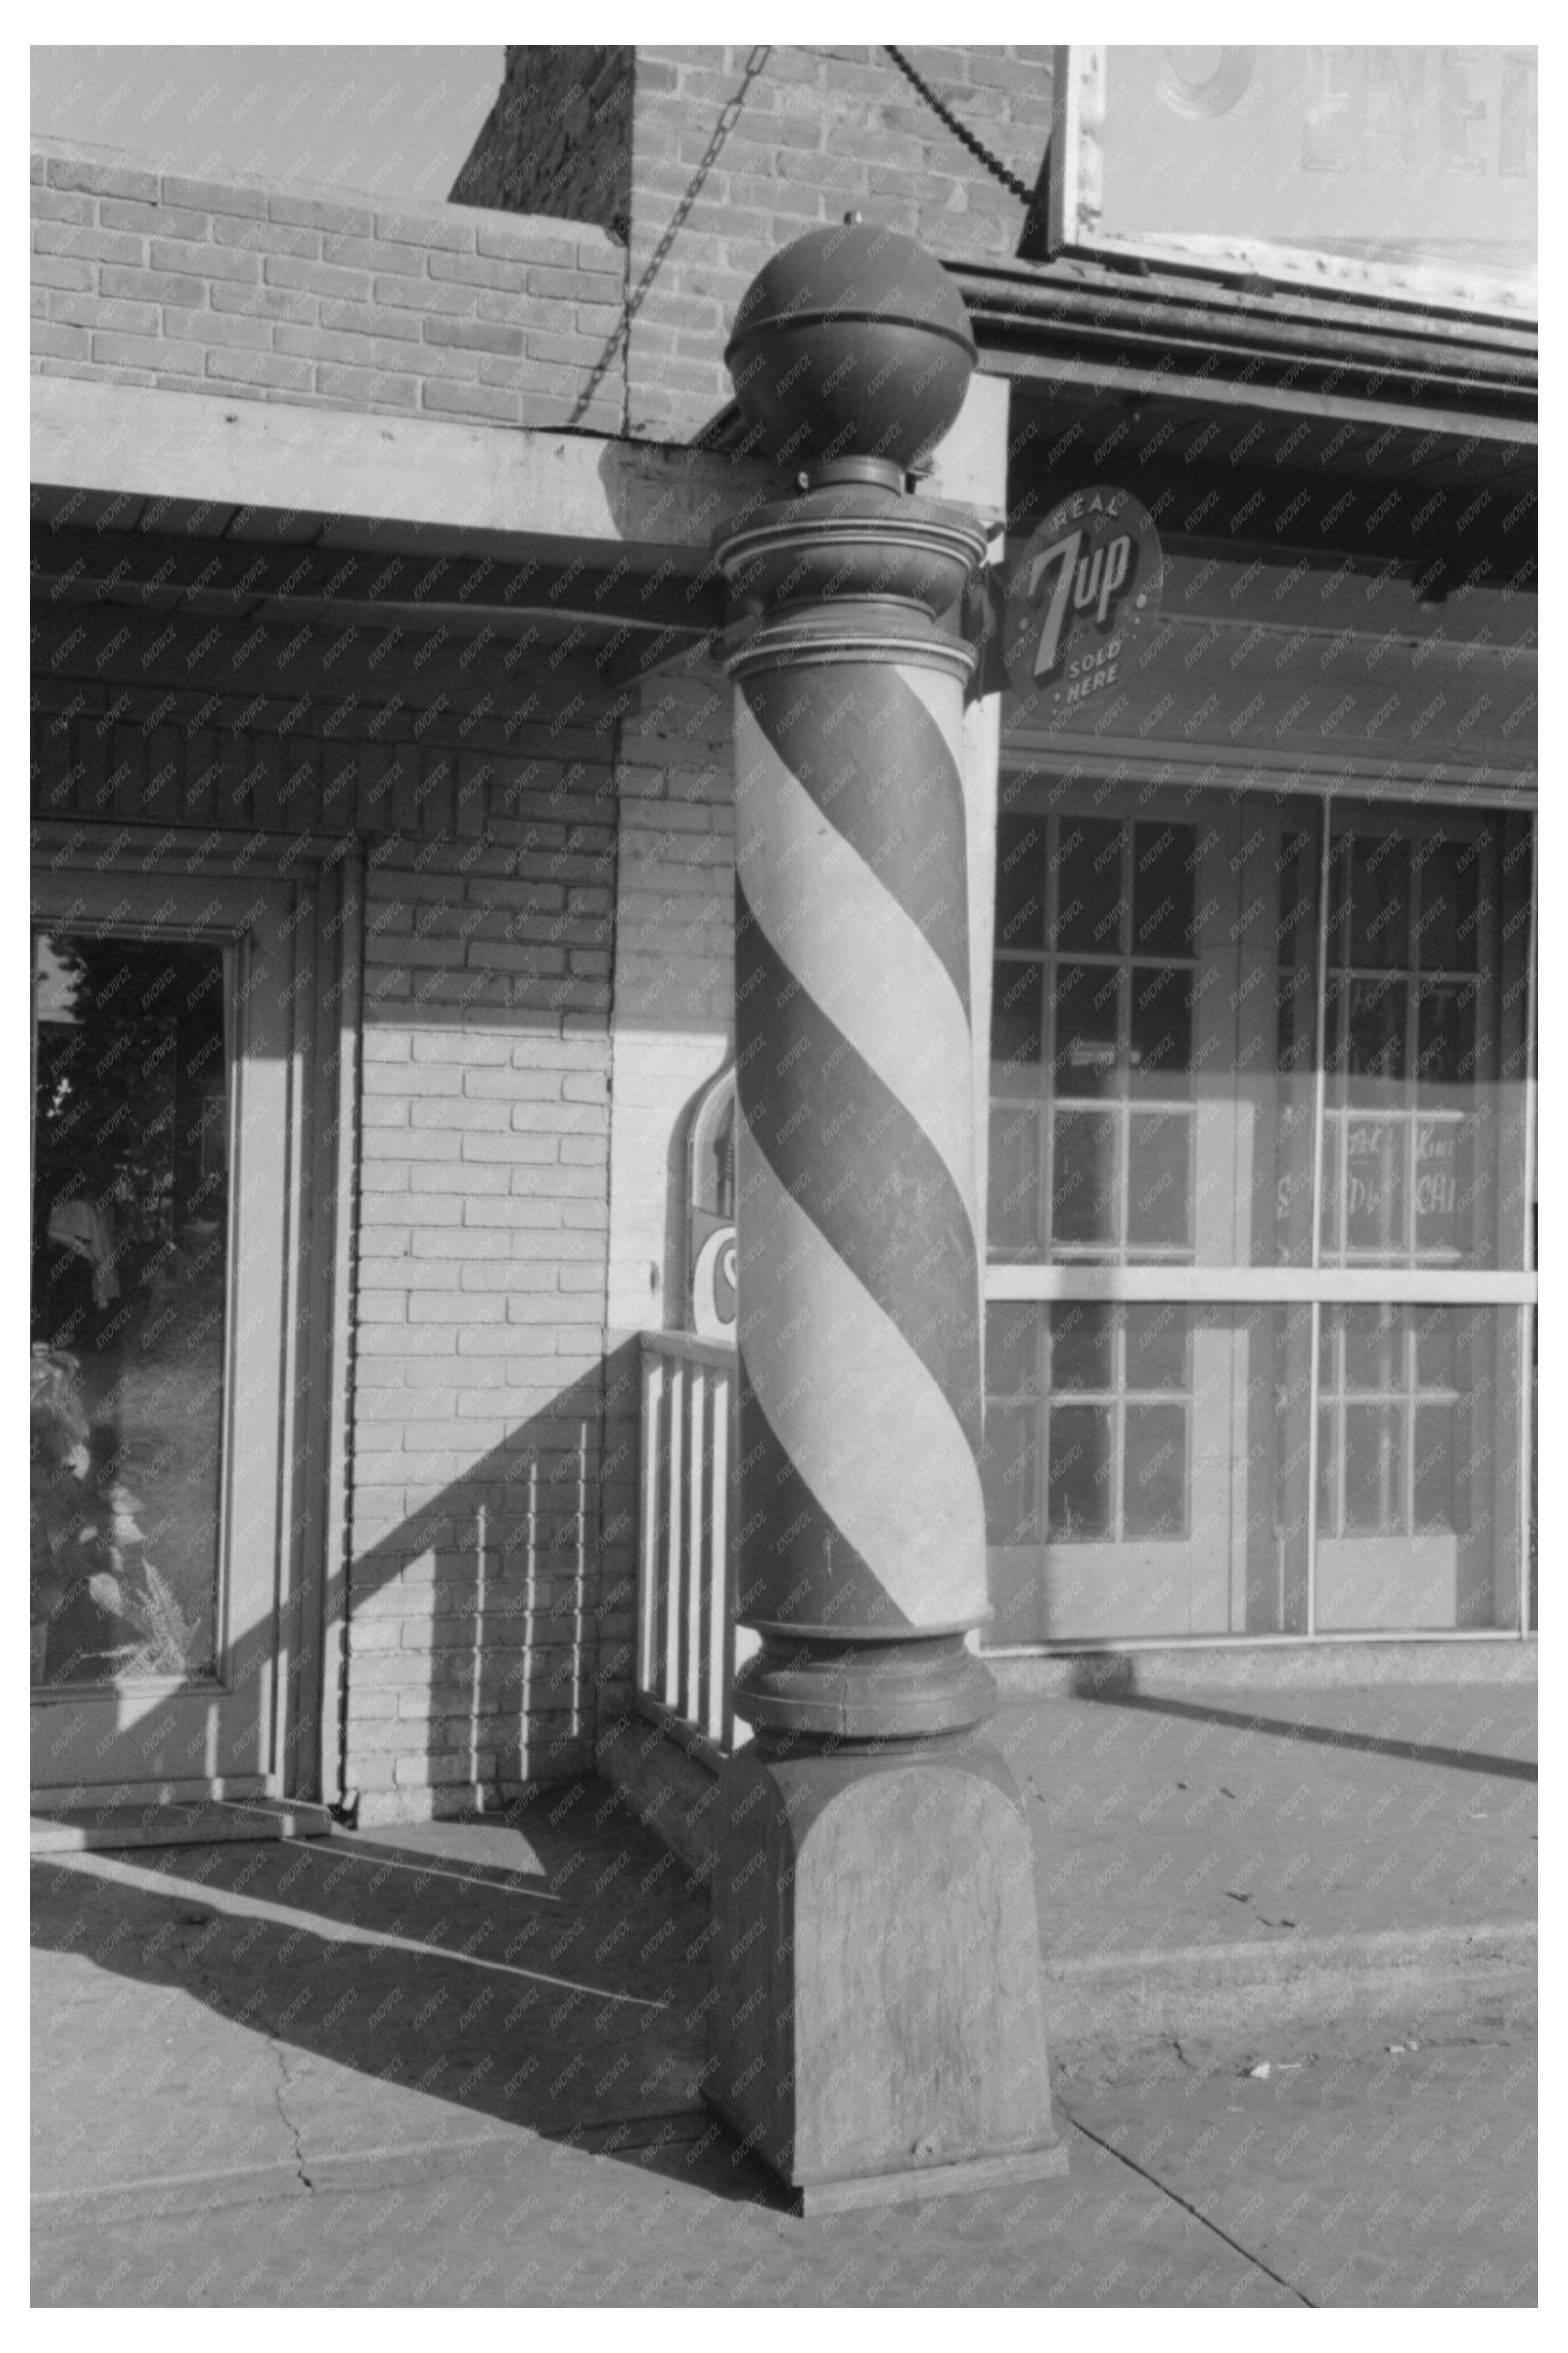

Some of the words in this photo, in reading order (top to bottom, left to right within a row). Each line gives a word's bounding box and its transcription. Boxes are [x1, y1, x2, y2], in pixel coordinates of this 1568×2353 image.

[1053, 492, 1119, 532] REAL
[1070, 640, 1121, 679] SOLD
[1067, 663, 1119, 704] HERE
